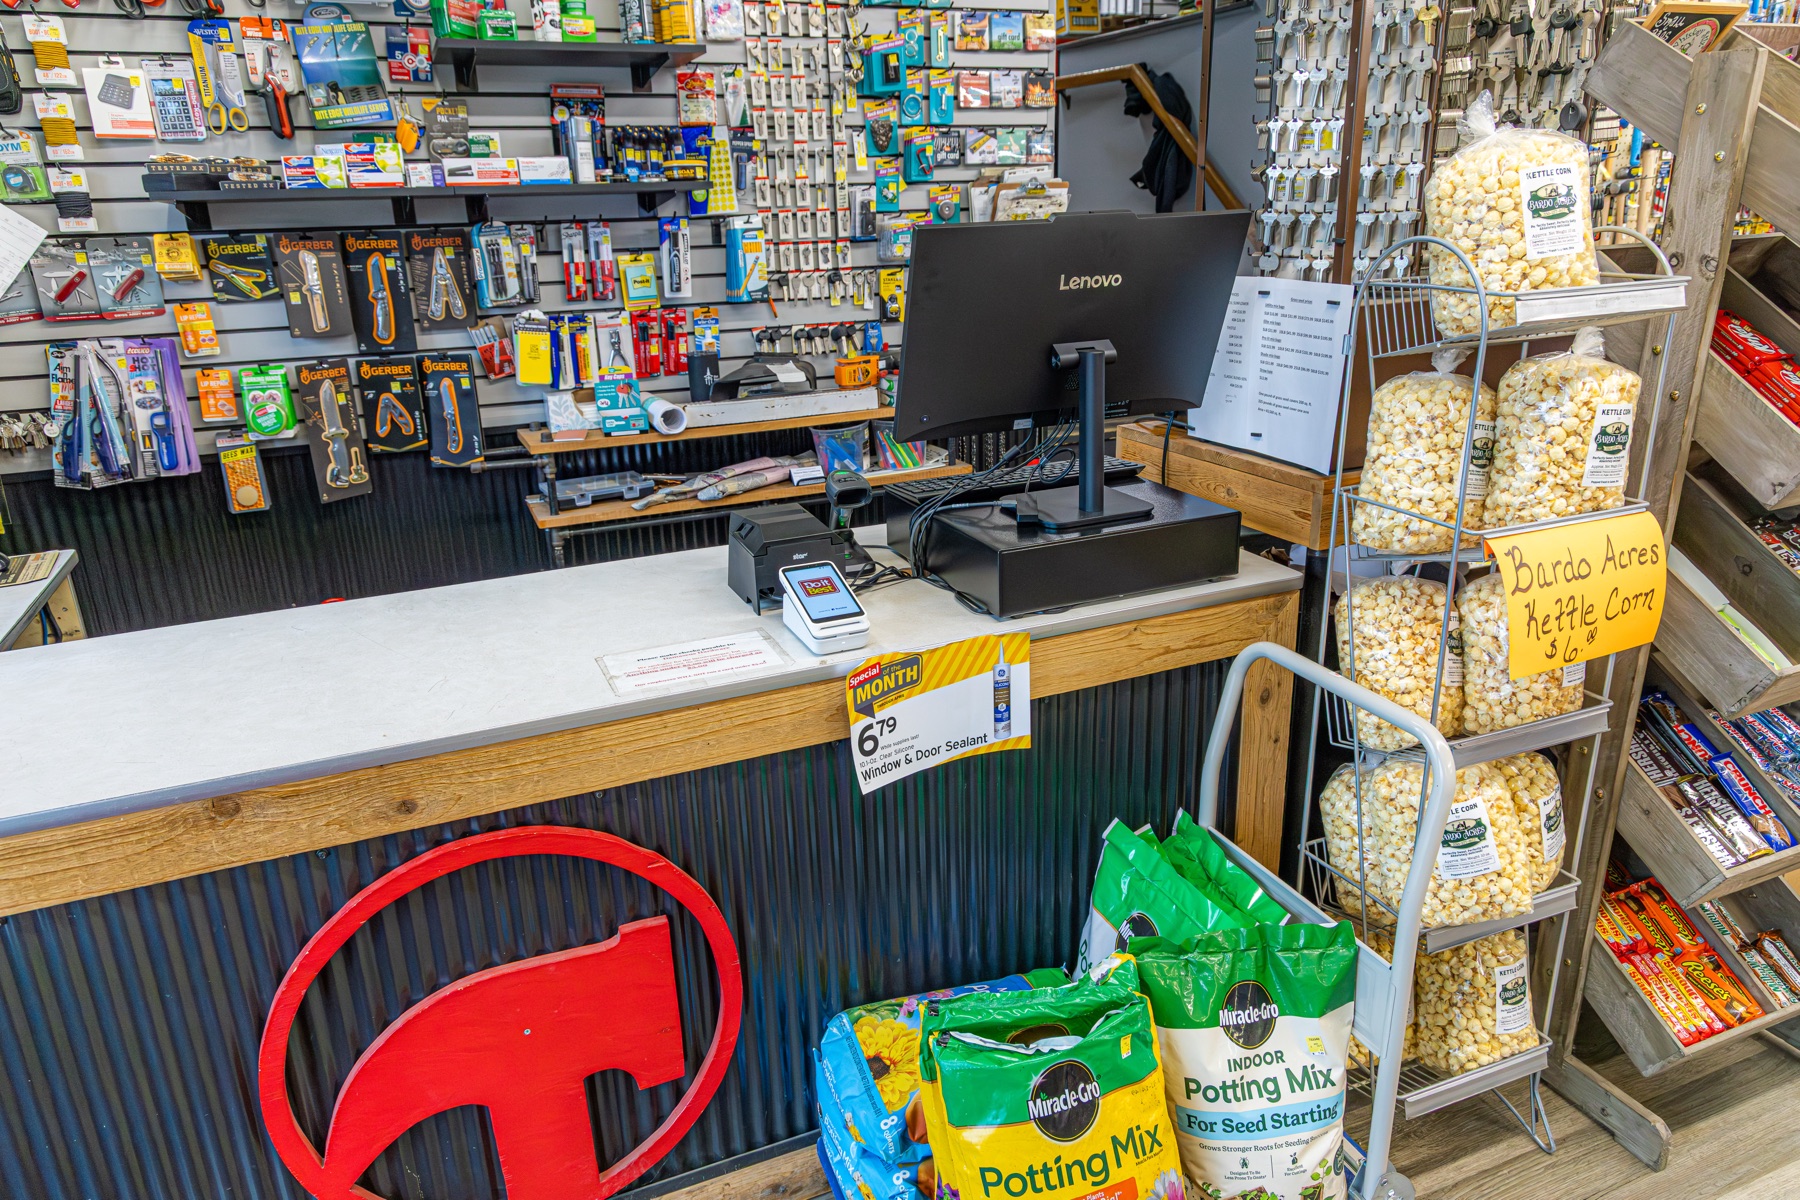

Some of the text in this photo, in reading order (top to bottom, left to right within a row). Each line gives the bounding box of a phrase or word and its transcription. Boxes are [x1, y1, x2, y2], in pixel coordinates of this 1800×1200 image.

[198, 66, 211, 97] TITANIUM
[937, 151, 960, 160] gift card
[1526, 169, 1554, 179] KETTLE
[1529, 198, 1553, 211] BARDO
[292, 241, 334, 251] GERBER
[357, 240, 398, 249] GERBER
[422, 237, 462, 247] GERBER
[220, 244, 264, 254] GERBER
[1060, 274, 1122, 290] Lenovo
[132, 356, 155, 364] HOT
[54, 362, 71, 372] Aim
[129, 364, 156, 373] SHOT
[370, 365, 412, 376] GERBER
[432, 362, 469, 371] GERBER
[311, 367, 347, 380] GERBER
[222, 452, 238, 460] BEES
[1504, 534, 1659, 596] Bardo Acres
[804, 579, 830, 589] Do it
[807, 585, 834, 596] Best
[1525, 587, 1655, 641] Kettle Corn
[849, 664, 901, 687] Special of the
[856, 664, 918, 704] MONTH
[892, 737, 909, 748] supplies
[860, 744, 914, 768] 10.1-Oz. Clear Silicone
[861, 733, 988, 782] Window & Door Sealant
[1723, 760, 1772, 816] CRUNCH
[1461, 803, 1478, 813] CORN
[1442, 832, 1462, 841] ARDO
[1500, 967, 1517, 976] KETTLE
[1682, 961, 1732, 1001] Reese's
[1219, 1003, 1279, 1027] Miracle-Gro
[1227, 1050, 1286, 1072] INDOOR
[1184, 1064, 1336, 1103] Potting Mix
[1028, 1080, 1100, 1120] Miracle-Gro
[1186, 1103, 1338, 1133] For Seed Starting
[880, 1115, 898, 1154] 8 QUARTS
[1199, 1143, 1221, 1152] Grows
[1254, 1144, 1273, 1152] Roots
[979, 1124, 1164, 1198] Potting Mix
[893, 1170, 910, 1186] 8
[1087, 1192, 1105, 1200] Plants
